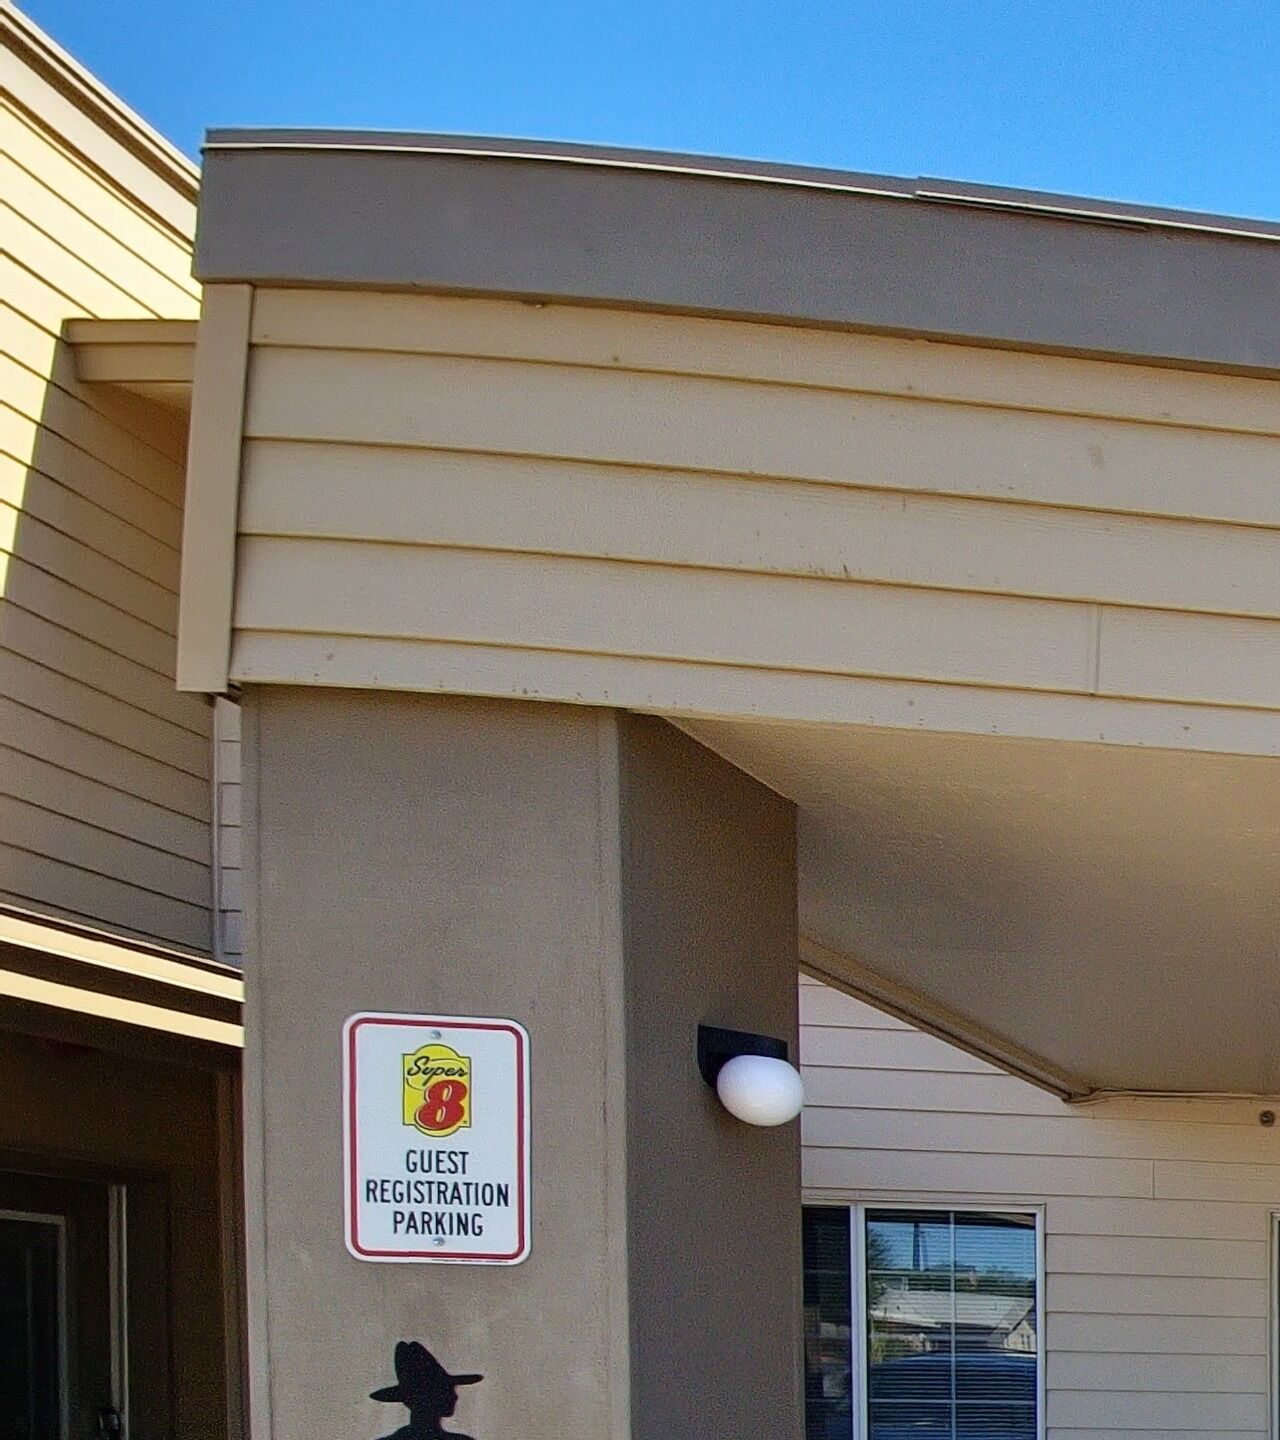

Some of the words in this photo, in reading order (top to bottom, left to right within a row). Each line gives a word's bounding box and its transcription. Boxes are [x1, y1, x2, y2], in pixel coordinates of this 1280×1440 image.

[407, 1055, 468, 1086] Super
[415, 1079, 468, 1131] 8
[405, 1149, 469, 1175] GUEST
[365, 1179, 510, 1208] REGISTRATION
[392, 1210, 484, 1237] PARKING
